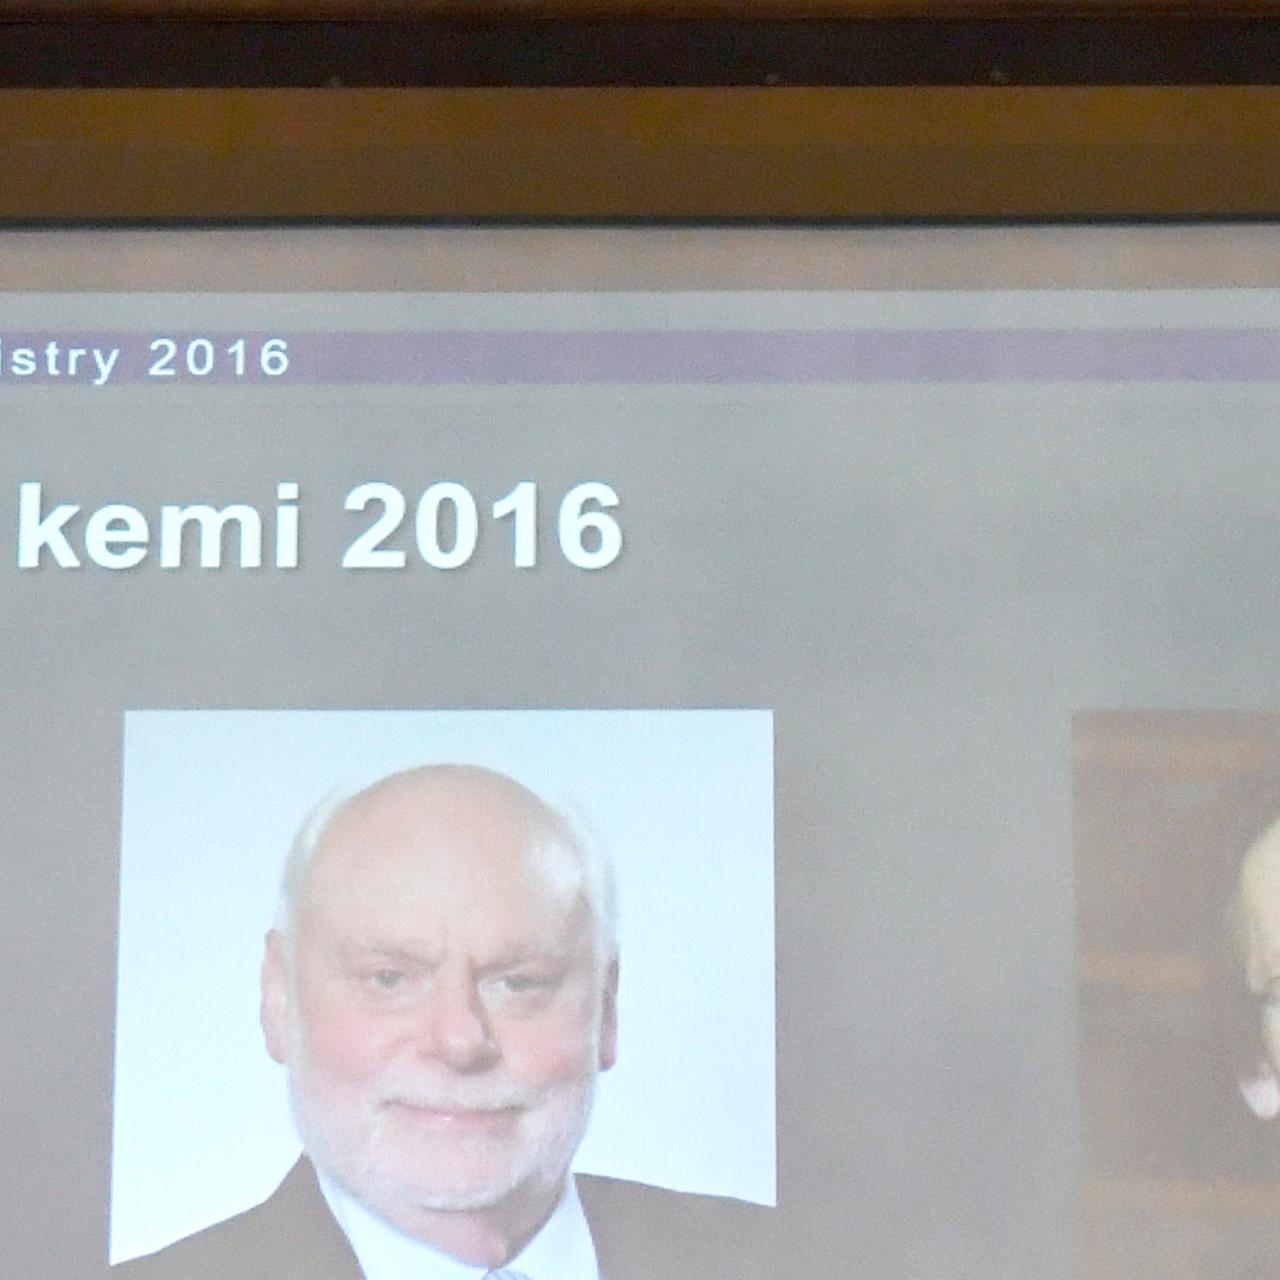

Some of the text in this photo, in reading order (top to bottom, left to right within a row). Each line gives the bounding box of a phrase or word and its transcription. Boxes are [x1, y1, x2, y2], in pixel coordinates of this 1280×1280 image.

[148, 338, 289, 376] 2016
[18, 482, 299, 569] kemi
[341, 481, 622, 569] 2016
